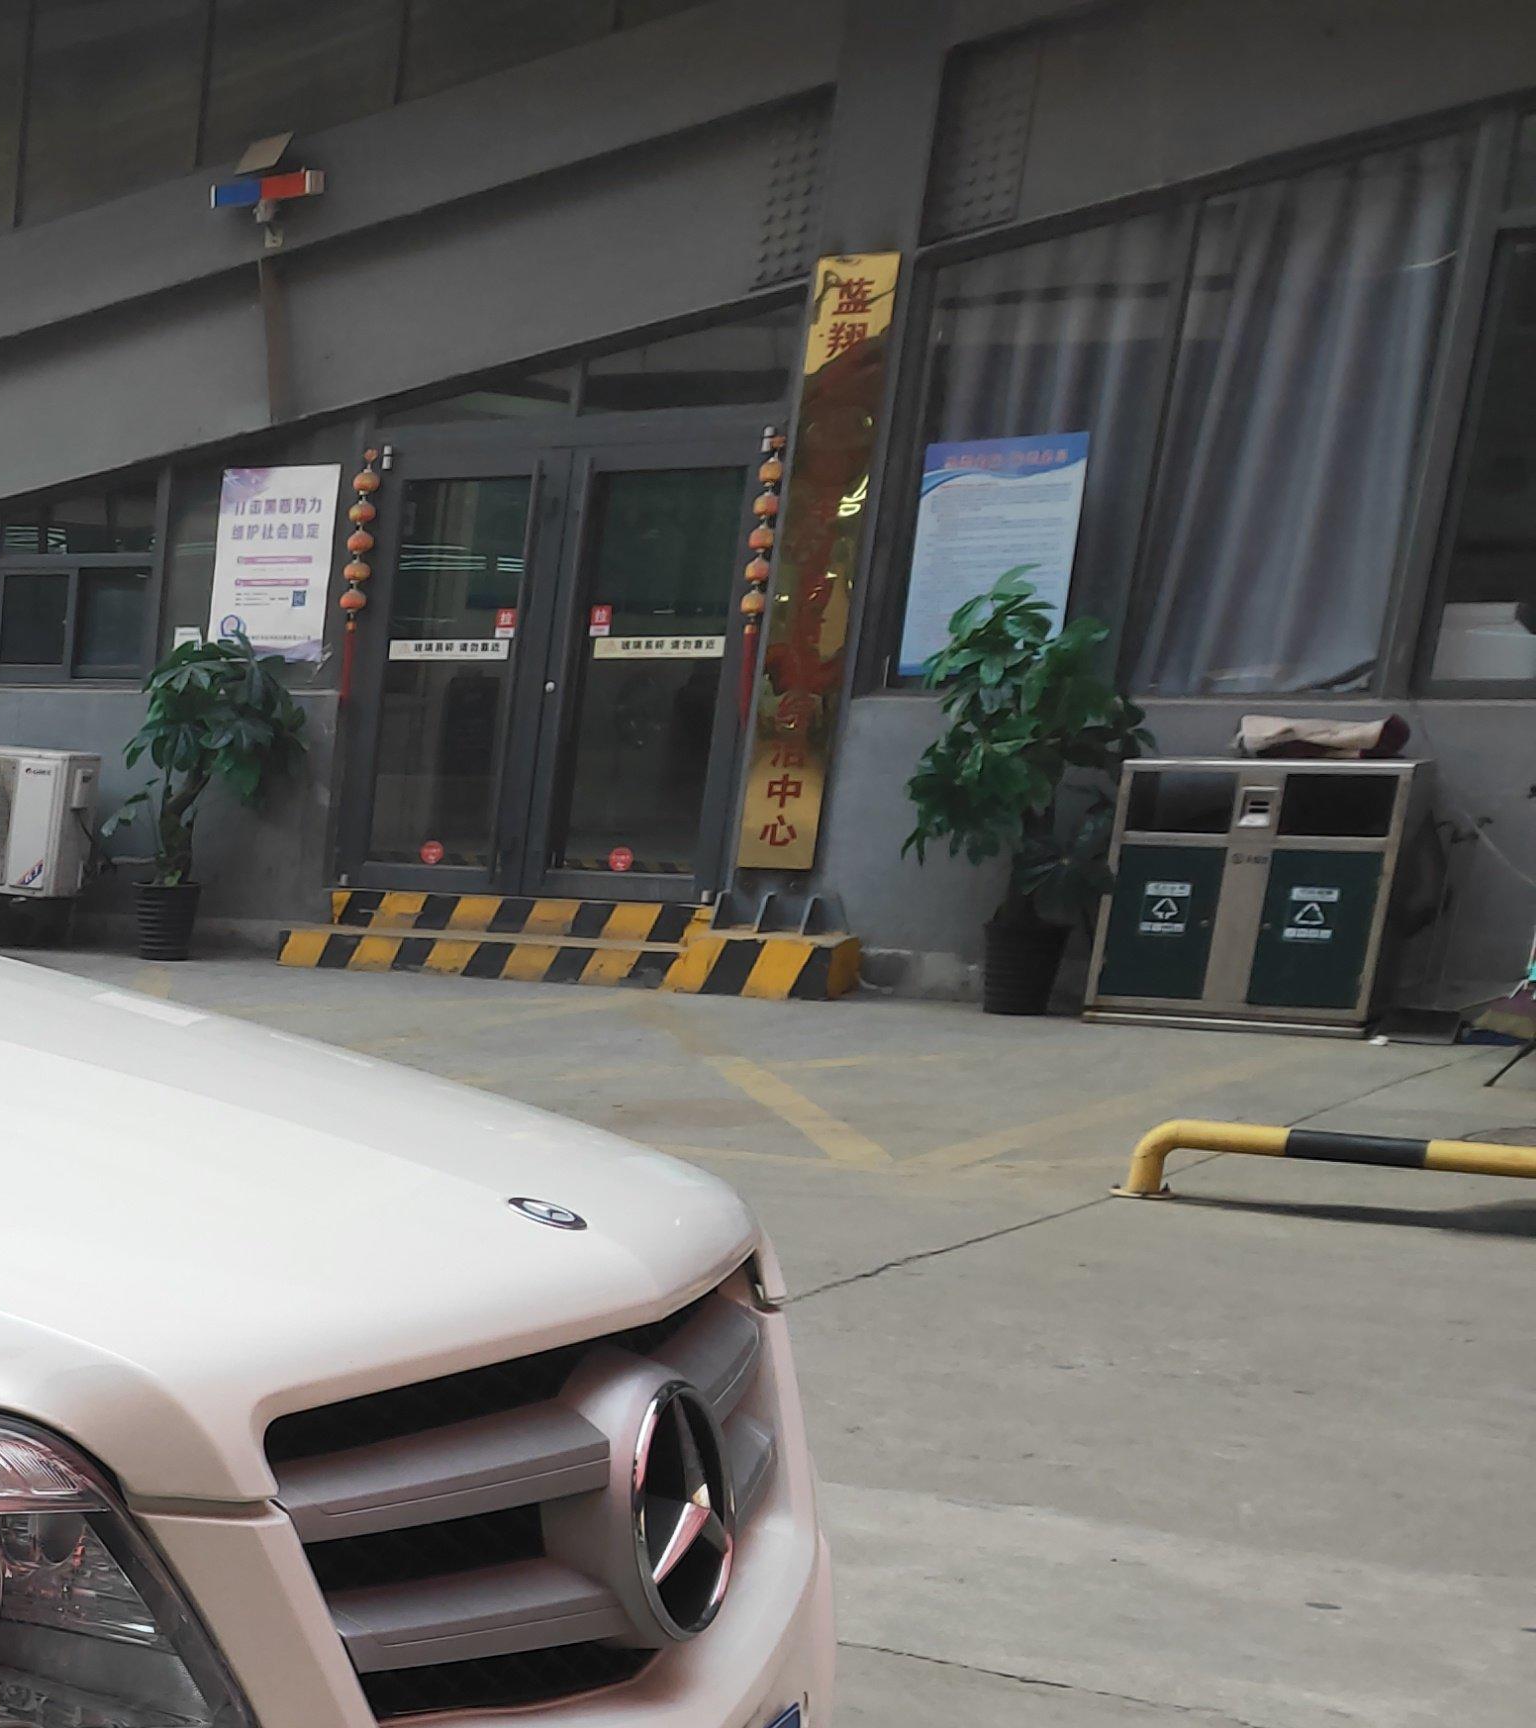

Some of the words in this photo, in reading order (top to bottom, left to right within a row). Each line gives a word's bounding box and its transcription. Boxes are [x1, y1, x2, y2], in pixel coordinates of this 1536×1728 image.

[231, 523, 321, 540] 维护社会稳定
